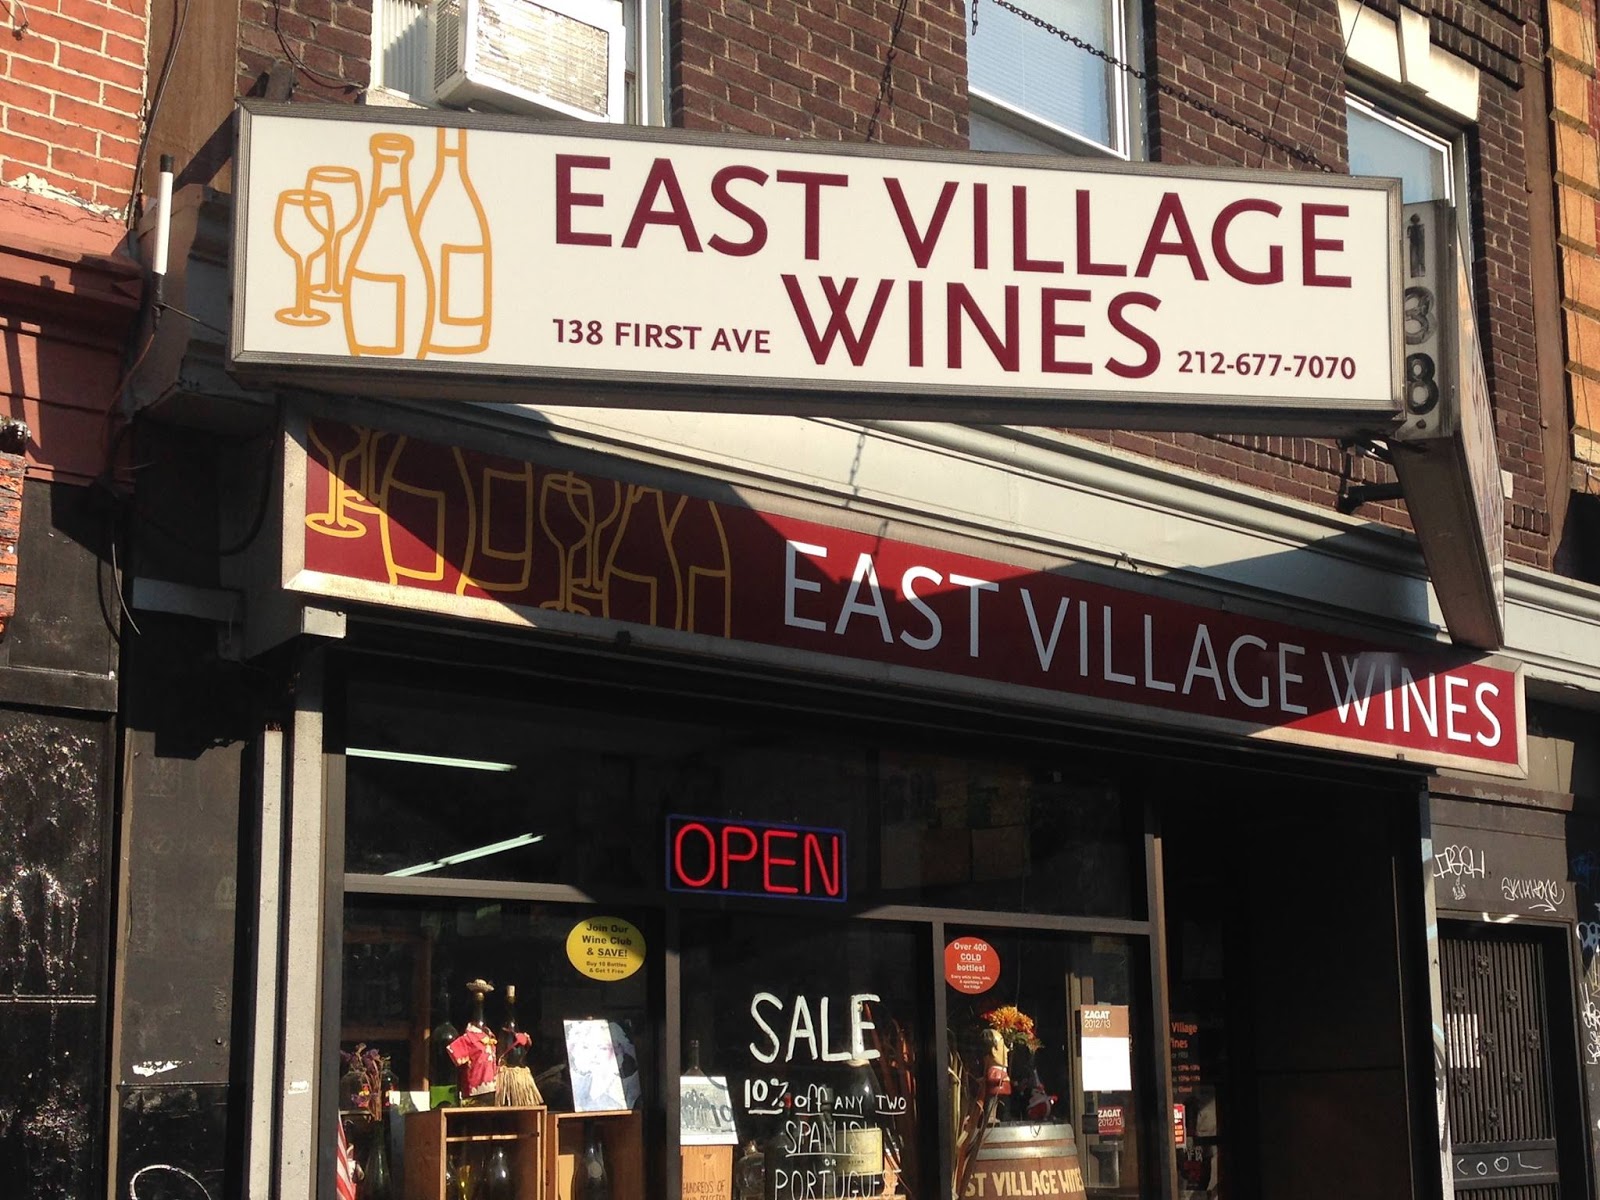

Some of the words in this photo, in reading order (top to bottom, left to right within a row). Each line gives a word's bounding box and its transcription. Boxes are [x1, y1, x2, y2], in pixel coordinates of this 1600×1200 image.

[556, 153, 848, 260] EAST
[883, 178, 1352, 288] VILLAGE
[781, 273, 1162, 379] WINES
[553, 319, 604, 346] 138
[615, 323, 702, 350] FIRST
[710, 328, 770, 354] AVE
[1178, 350, 1356, 380] 212-677-7070
[784, 539, 1000, 658] EAST
[1020, 587, 1308, 715] VILLAGE
[1322, 651, 1502, 747] WINES
[675, 823, 839, 896] OPEN
[586, 924, 608, 933] Join
[610, 925, 629, 934] Our
[582, 935, 607, 944] Wine
[610, 936, 632, 946] Club
[954, 942, 971, 950] Over
[974, 943, 987, 951] 400
[586, 947, 594, 956] &
[597, 948, 628, 958] SAVE!
[960, 952, 982, 962] COLD
[956, 963, 986, 972] bottles!
[1084, 1010, 1111, 1020] ZAGAT
[749, 991, 881, 1063] SALE
[1084, 1019, 1111, 1028] 2012/13
[1172, 1022, 1198, 1035] Village
[744, 1077, 789, 1108] 10%
[794, 1083, 829, 1113] off
[834, 1096, 864, 1115] ANY
[875, 1094, 907, 1111] TWO
[1098, 1109, 1121, 1118] ZAGAT
[1098, 1117, 1122, 1127] 2012/13
[824, 1158, 837, 1167] OR
[1456, 1152, 1542, 1175] COOL
[717, 1179, 726, 1192] OF
[992, 1169, 1059, 1197] VILLAGE
